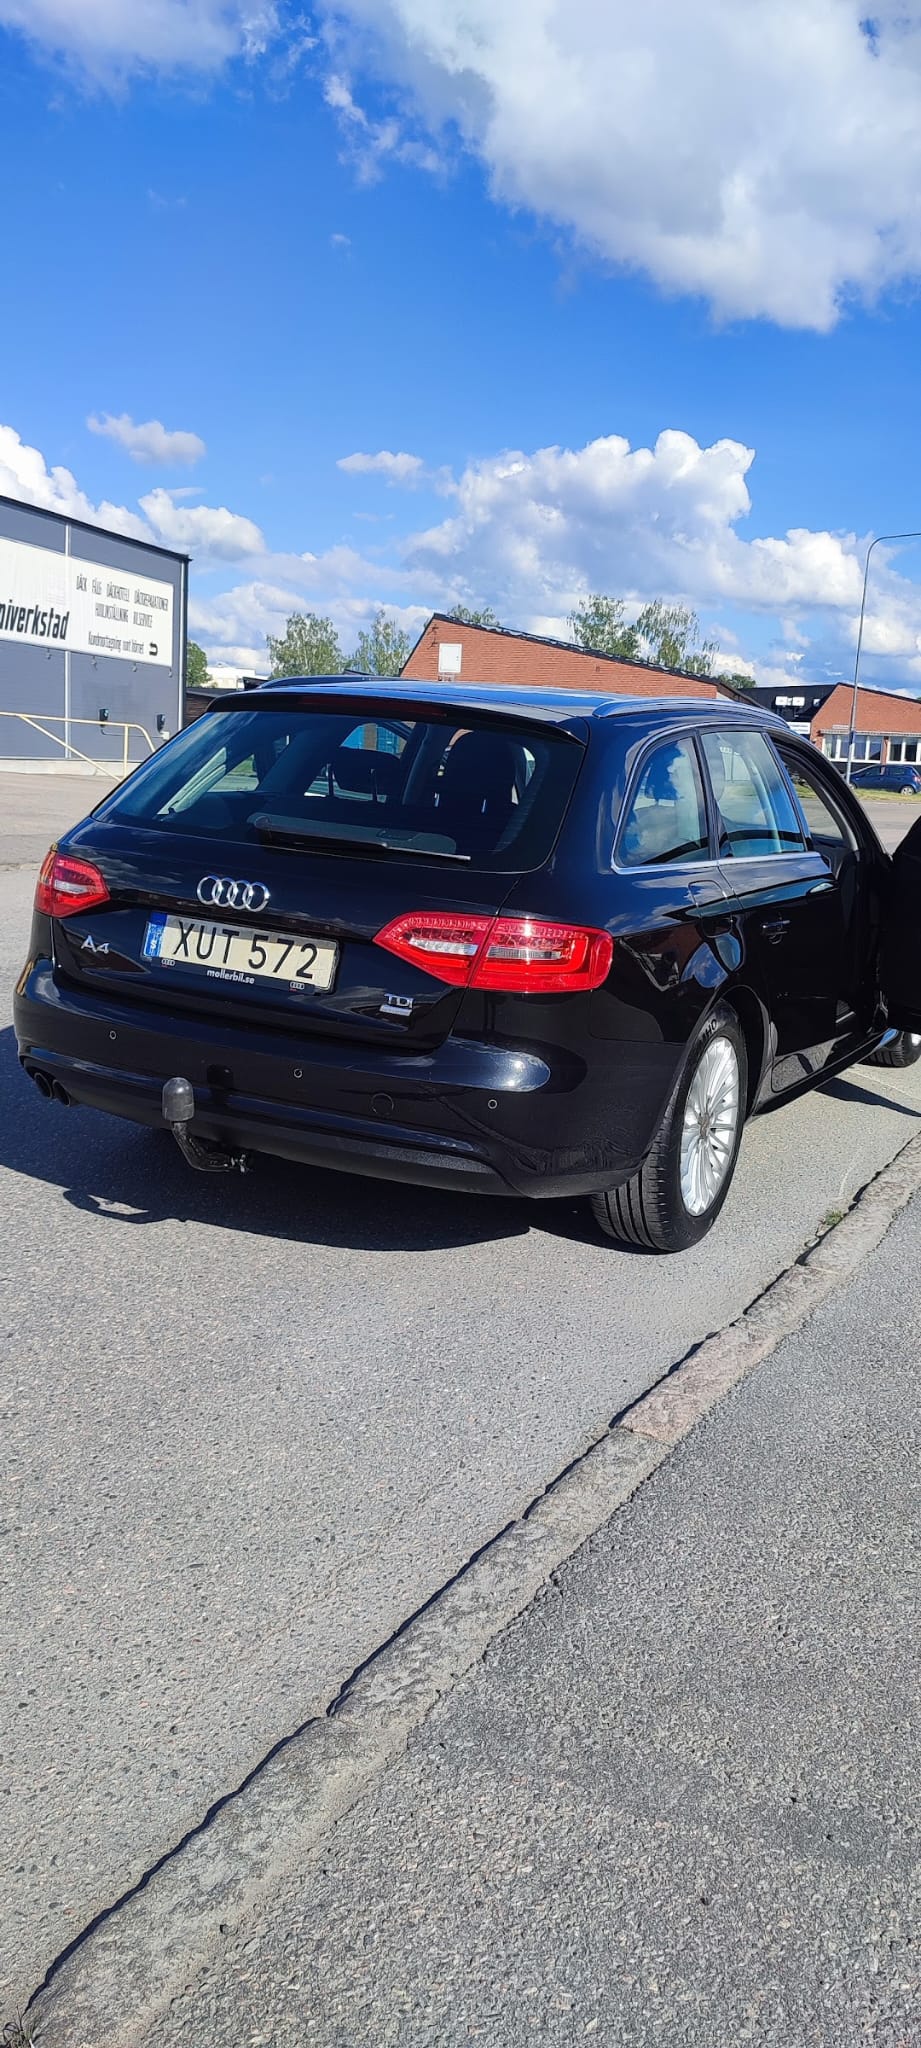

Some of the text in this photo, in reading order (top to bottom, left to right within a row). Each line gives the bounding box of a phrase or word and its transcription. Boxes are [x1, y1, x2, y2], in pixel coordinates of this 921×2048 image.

[80, 935, 110, 954] A4
[150, 940, 157, 949] S
[173, 920, 318, 979] XUT 572
[207, 968, 255, 985] mollerbil.se
[384, 993, 414, 1008] TDI
